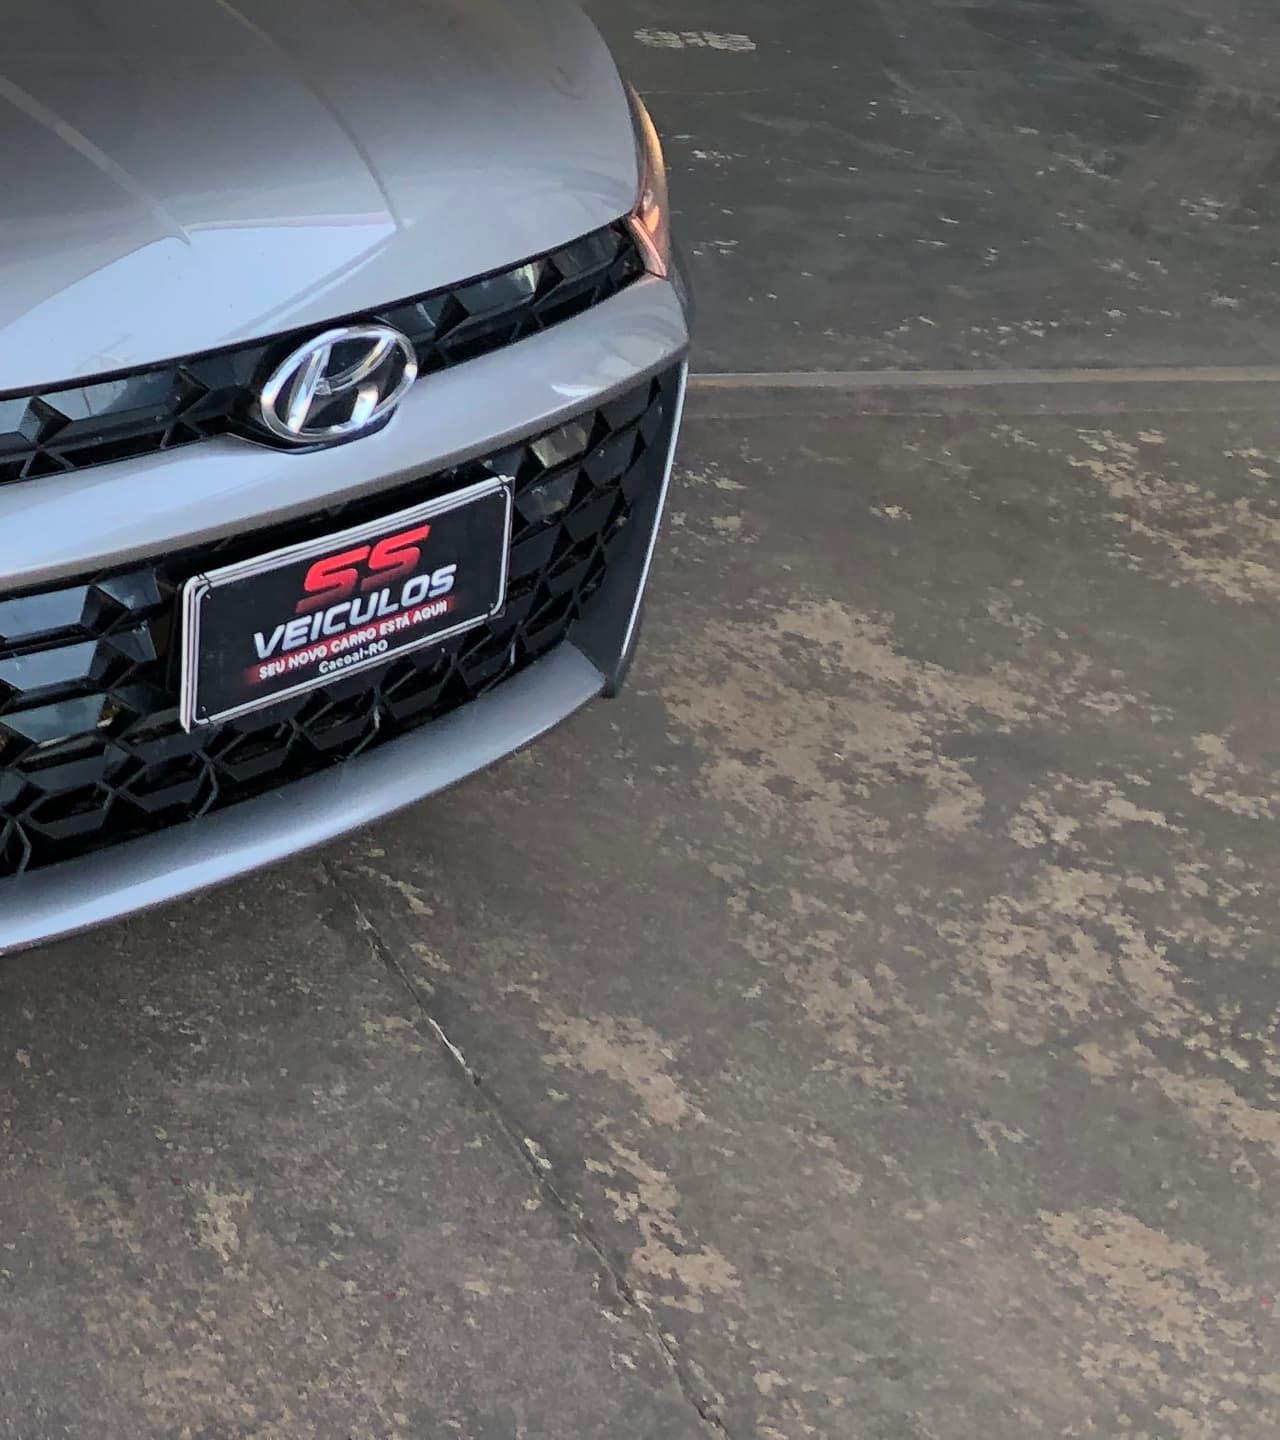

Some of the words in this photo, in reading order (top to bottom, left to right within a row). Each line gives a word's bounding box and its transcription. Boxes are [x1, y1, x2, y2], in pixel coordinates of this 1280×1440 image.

[253, 564, 457, 660] VEICULOS
[258, 659, 285, 680] SEU
[288, 645, 328, 669] NOVO
[330, 627, 377, 652] CARRO
[380, 613, 411, 636] ESTÁ
